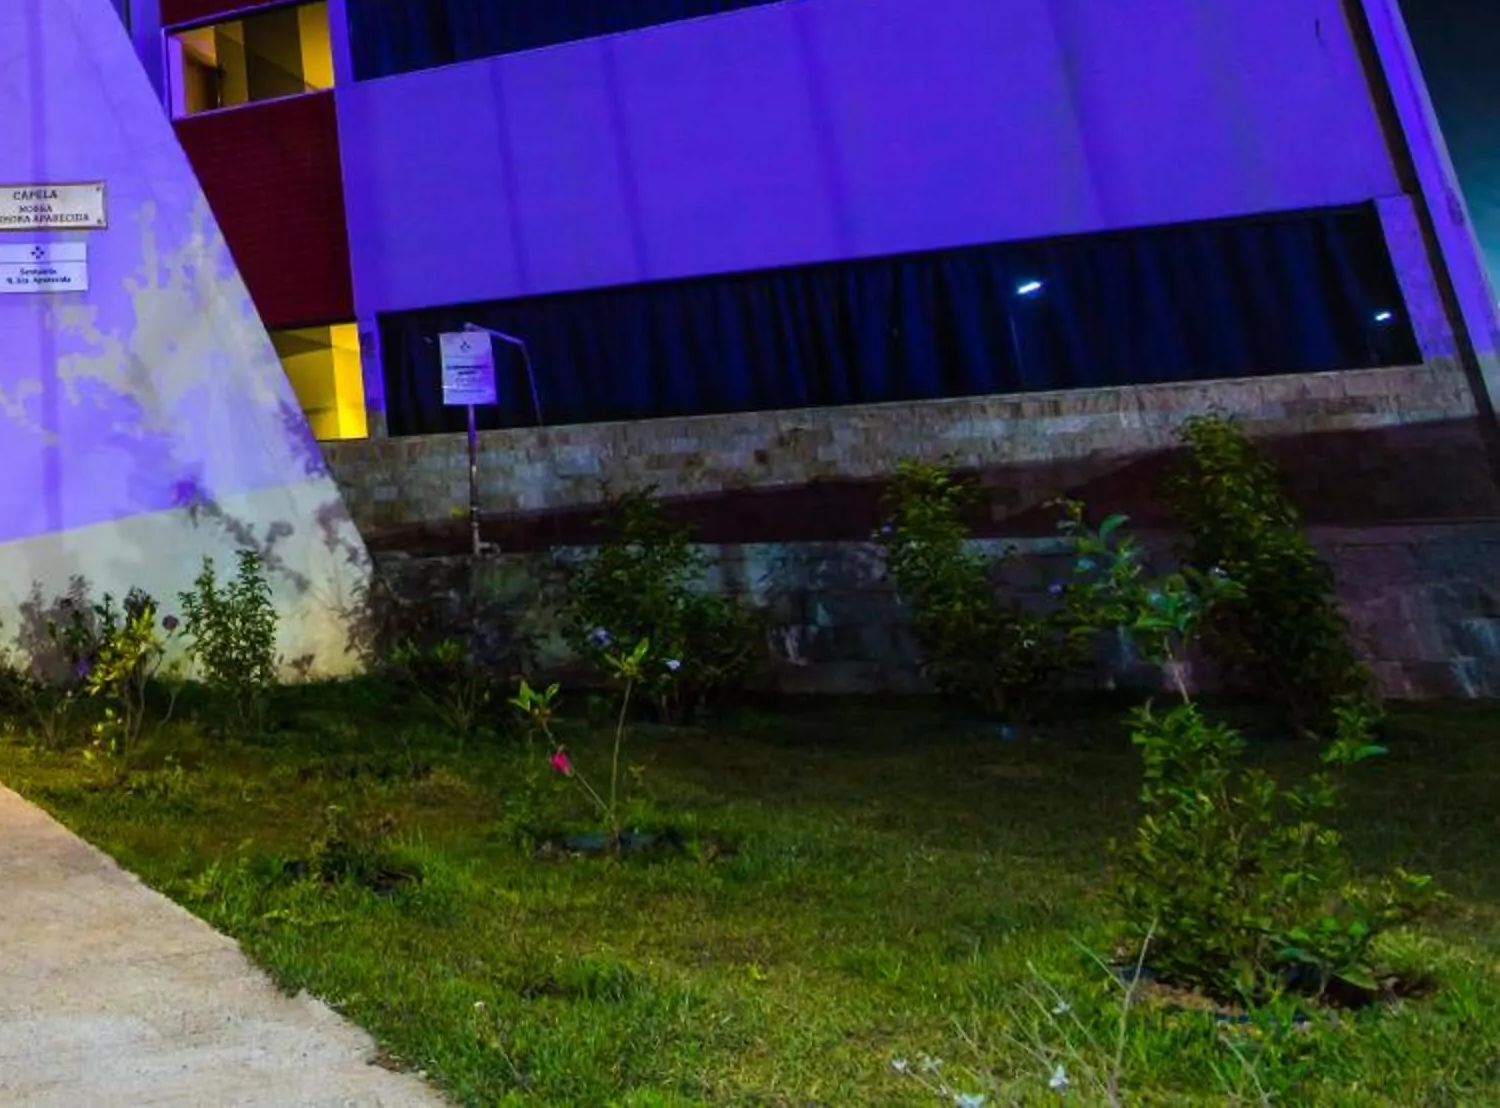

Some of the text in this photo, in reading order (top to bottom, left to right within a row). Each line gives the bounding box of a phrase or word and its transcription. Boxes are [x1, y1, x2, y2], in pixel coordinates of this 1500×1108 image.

[13, 189, 58, 201] CAPELA
[19, 204, 53, 213] NOSSA
[33, 213, 89, 223] APARECIDA
